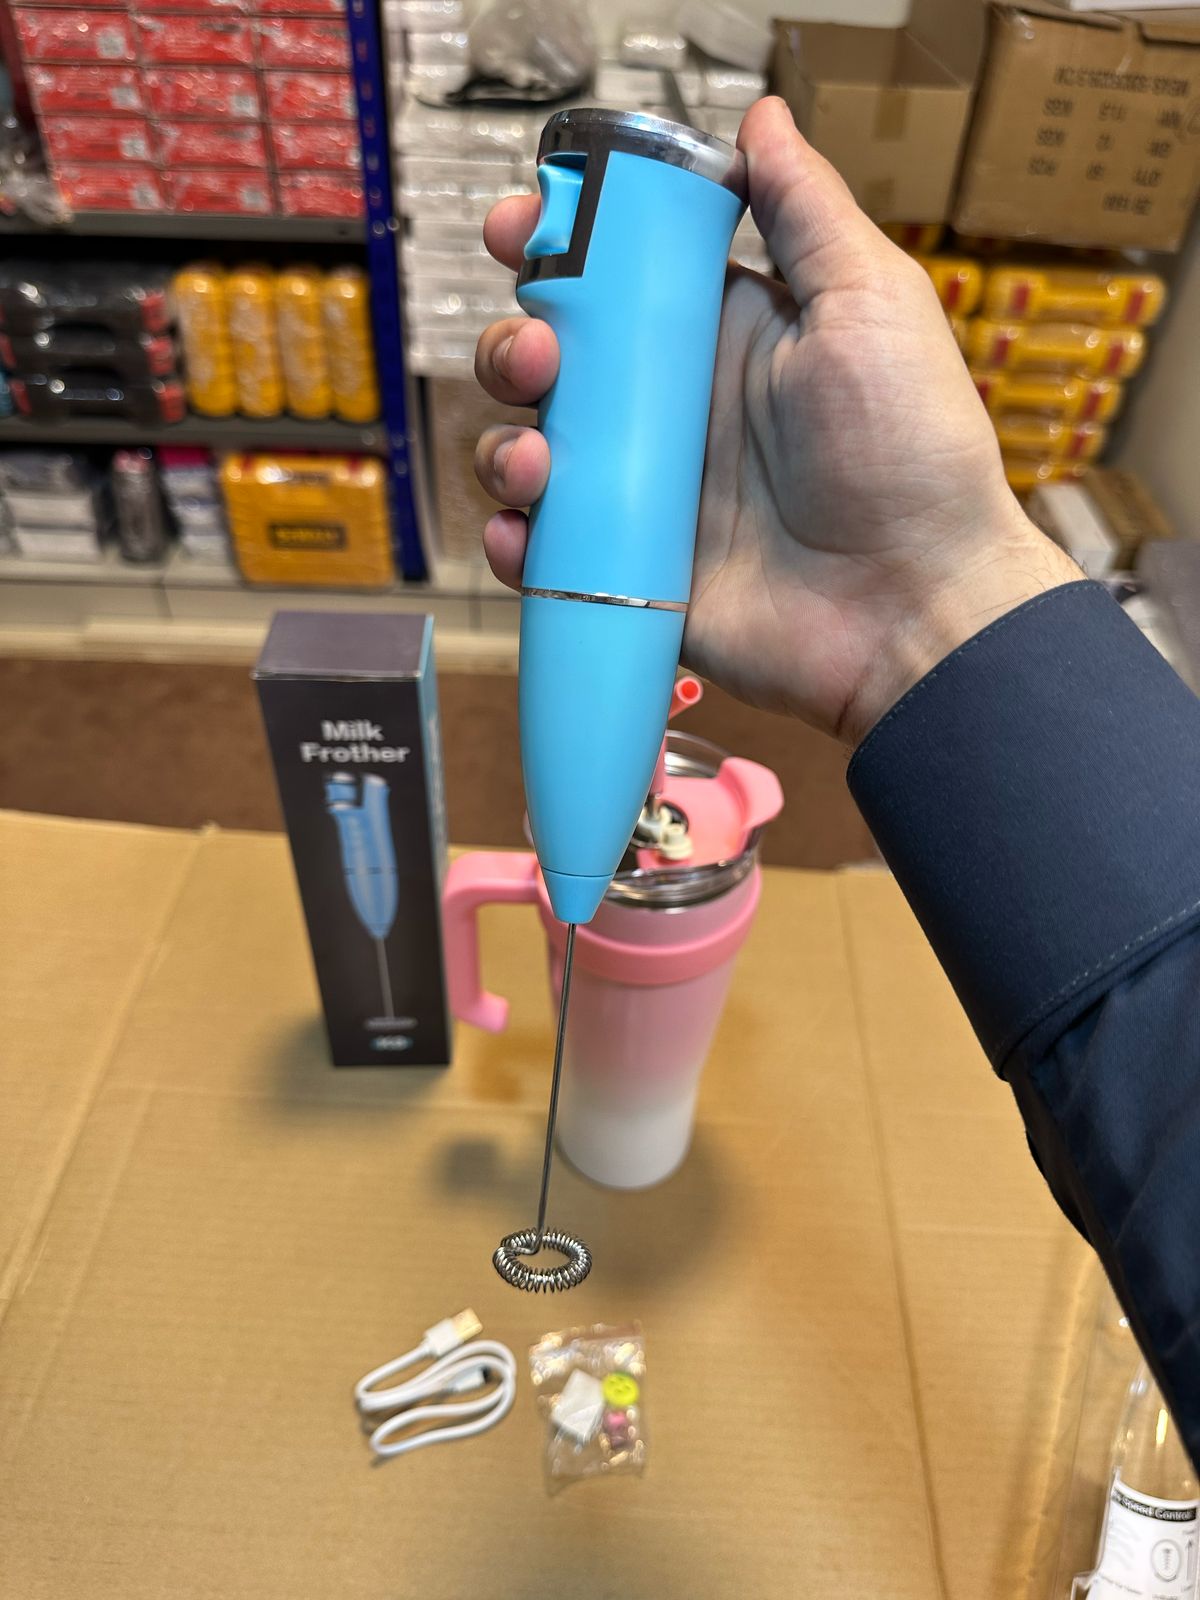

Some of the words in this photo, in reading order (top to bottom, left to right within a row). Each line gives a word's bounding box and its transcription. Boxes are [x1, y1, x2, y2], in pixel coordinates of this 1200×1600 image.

[322, 719, 384, 741] Milk
[300, 742, 411, 763] Frother
[1155, 1507, 1193, 1521] Control
